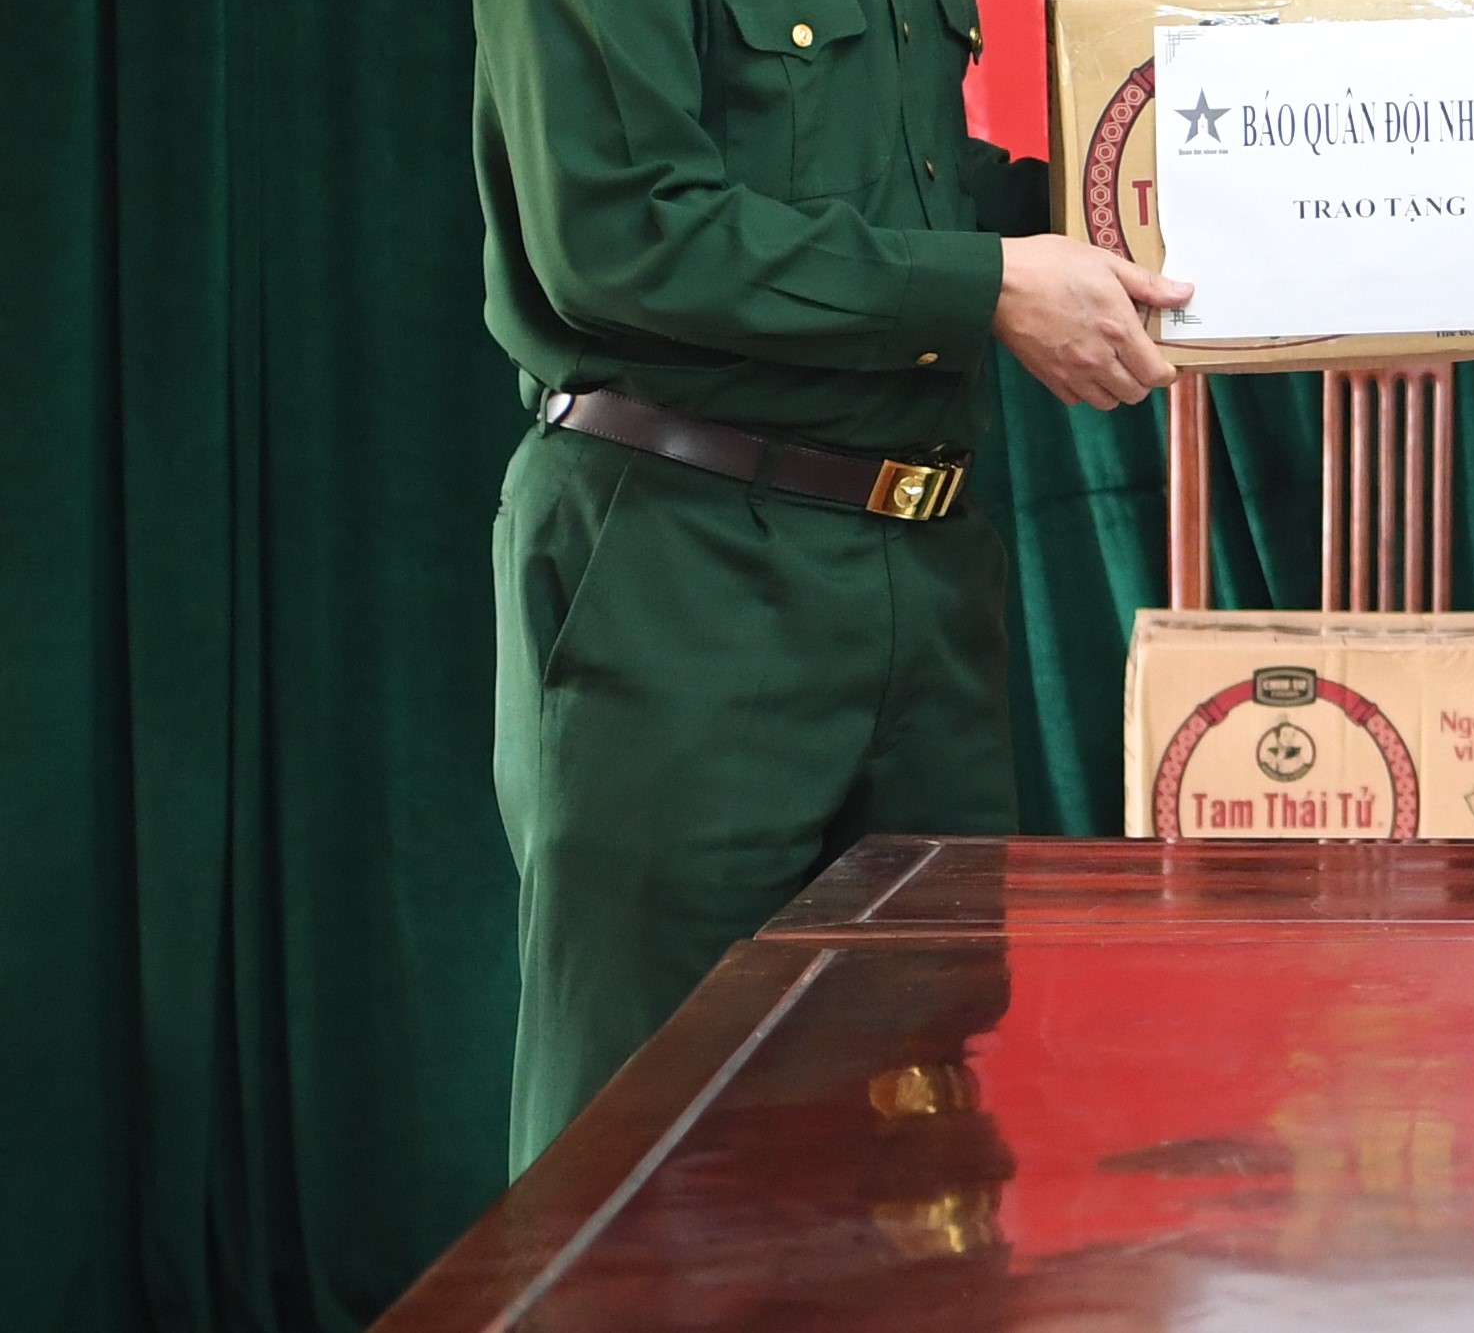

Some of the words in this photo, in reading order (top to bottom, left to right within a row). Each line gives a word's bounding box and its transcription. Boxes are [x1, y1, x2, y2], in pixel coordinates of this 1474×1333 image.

[1242, 90, 1296, 147] BÁO
[1303, 87, 1376, 156] QUÂN
[1385, 93, 1431, 156] ĐỘI
[1292, 197, 1377, 220] TRAO
[1383, 194, 1467, 223] TẶNG
[1191, 792, 1254, 829] Tam
[1263, 789, 1328, 829] Thái
[1336, 785, 1376, 829] Tử
